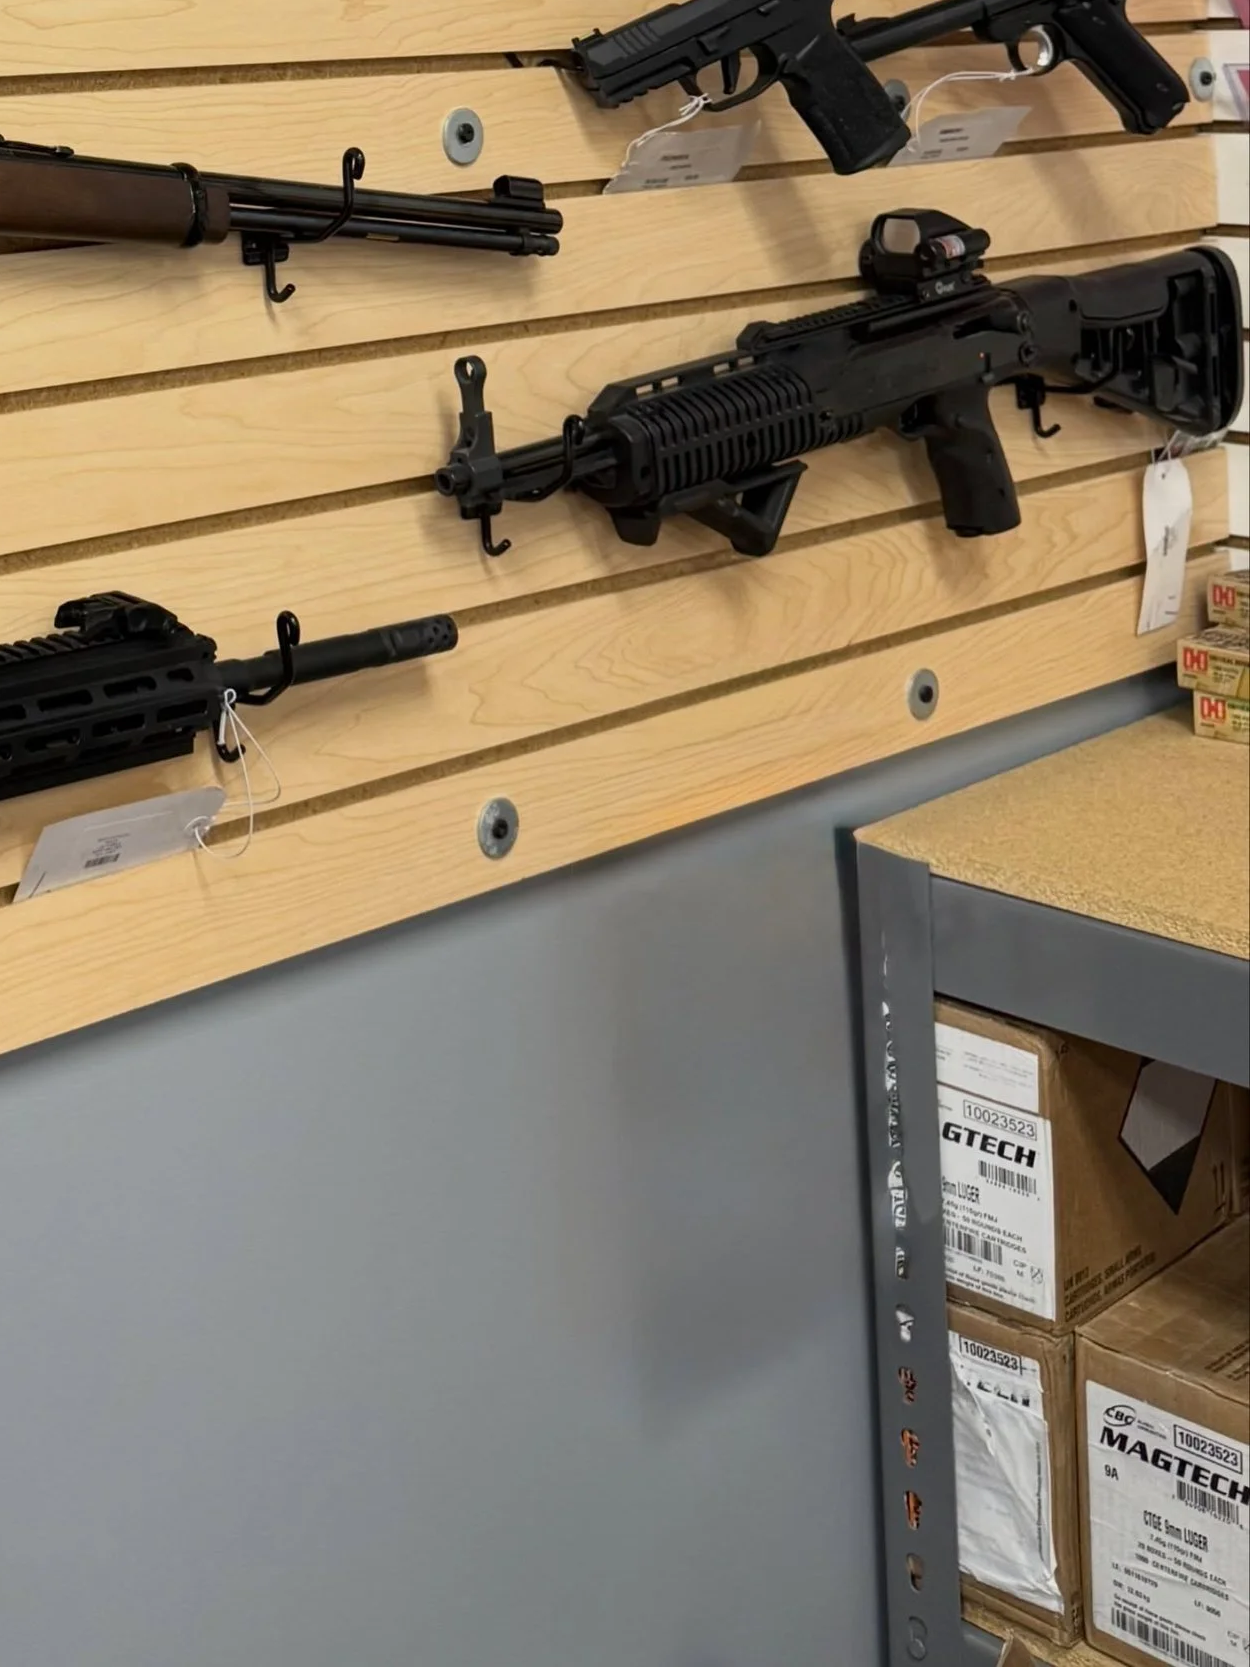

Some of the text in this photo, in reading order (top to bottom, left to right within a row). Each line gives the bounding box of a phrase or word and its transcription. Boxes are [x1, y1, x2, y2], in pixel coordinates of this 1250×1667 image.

[966, 1104, 1036, 1138] 10023523
[942, 1121, 1037, 1168] GTECH
[963, 1340, 1019, 1371] 10023523
[1104, 1406, 1136, 1426] CBC
[1179, 1431, 1239, 1467] 10023523
[1100, 1426, 1249, 1505] MAGTECH
[1104, 1464, 1119, 1480] 9A
[1184, 1528, 1209, 1553] LUGER
